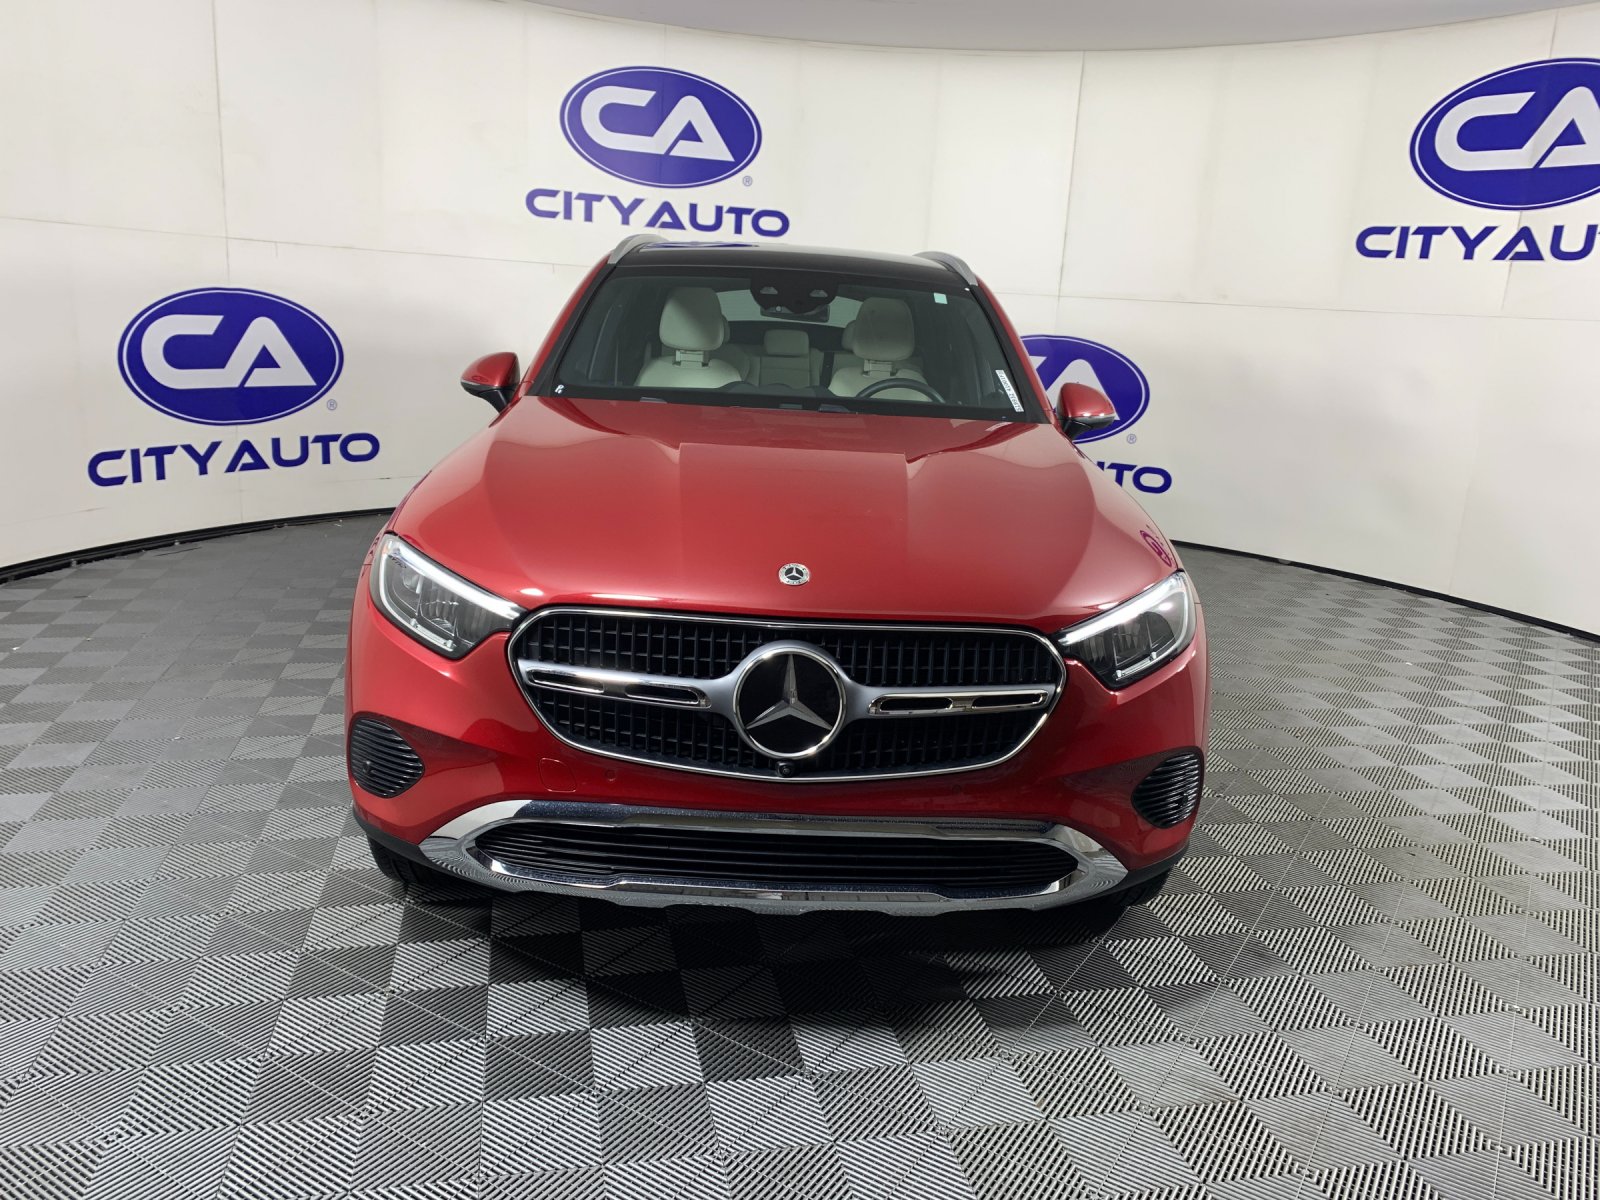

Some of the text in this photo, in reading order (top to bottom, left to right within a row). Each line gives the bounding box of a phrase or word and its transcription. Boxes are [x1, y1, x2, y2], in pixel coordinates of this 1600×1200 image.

[580, 85, 735, 162] CA
[1434, 86, 1600, 171] CA
[141, 314, 317, 389] CA
[1097, 461, 1172, 494] TO
